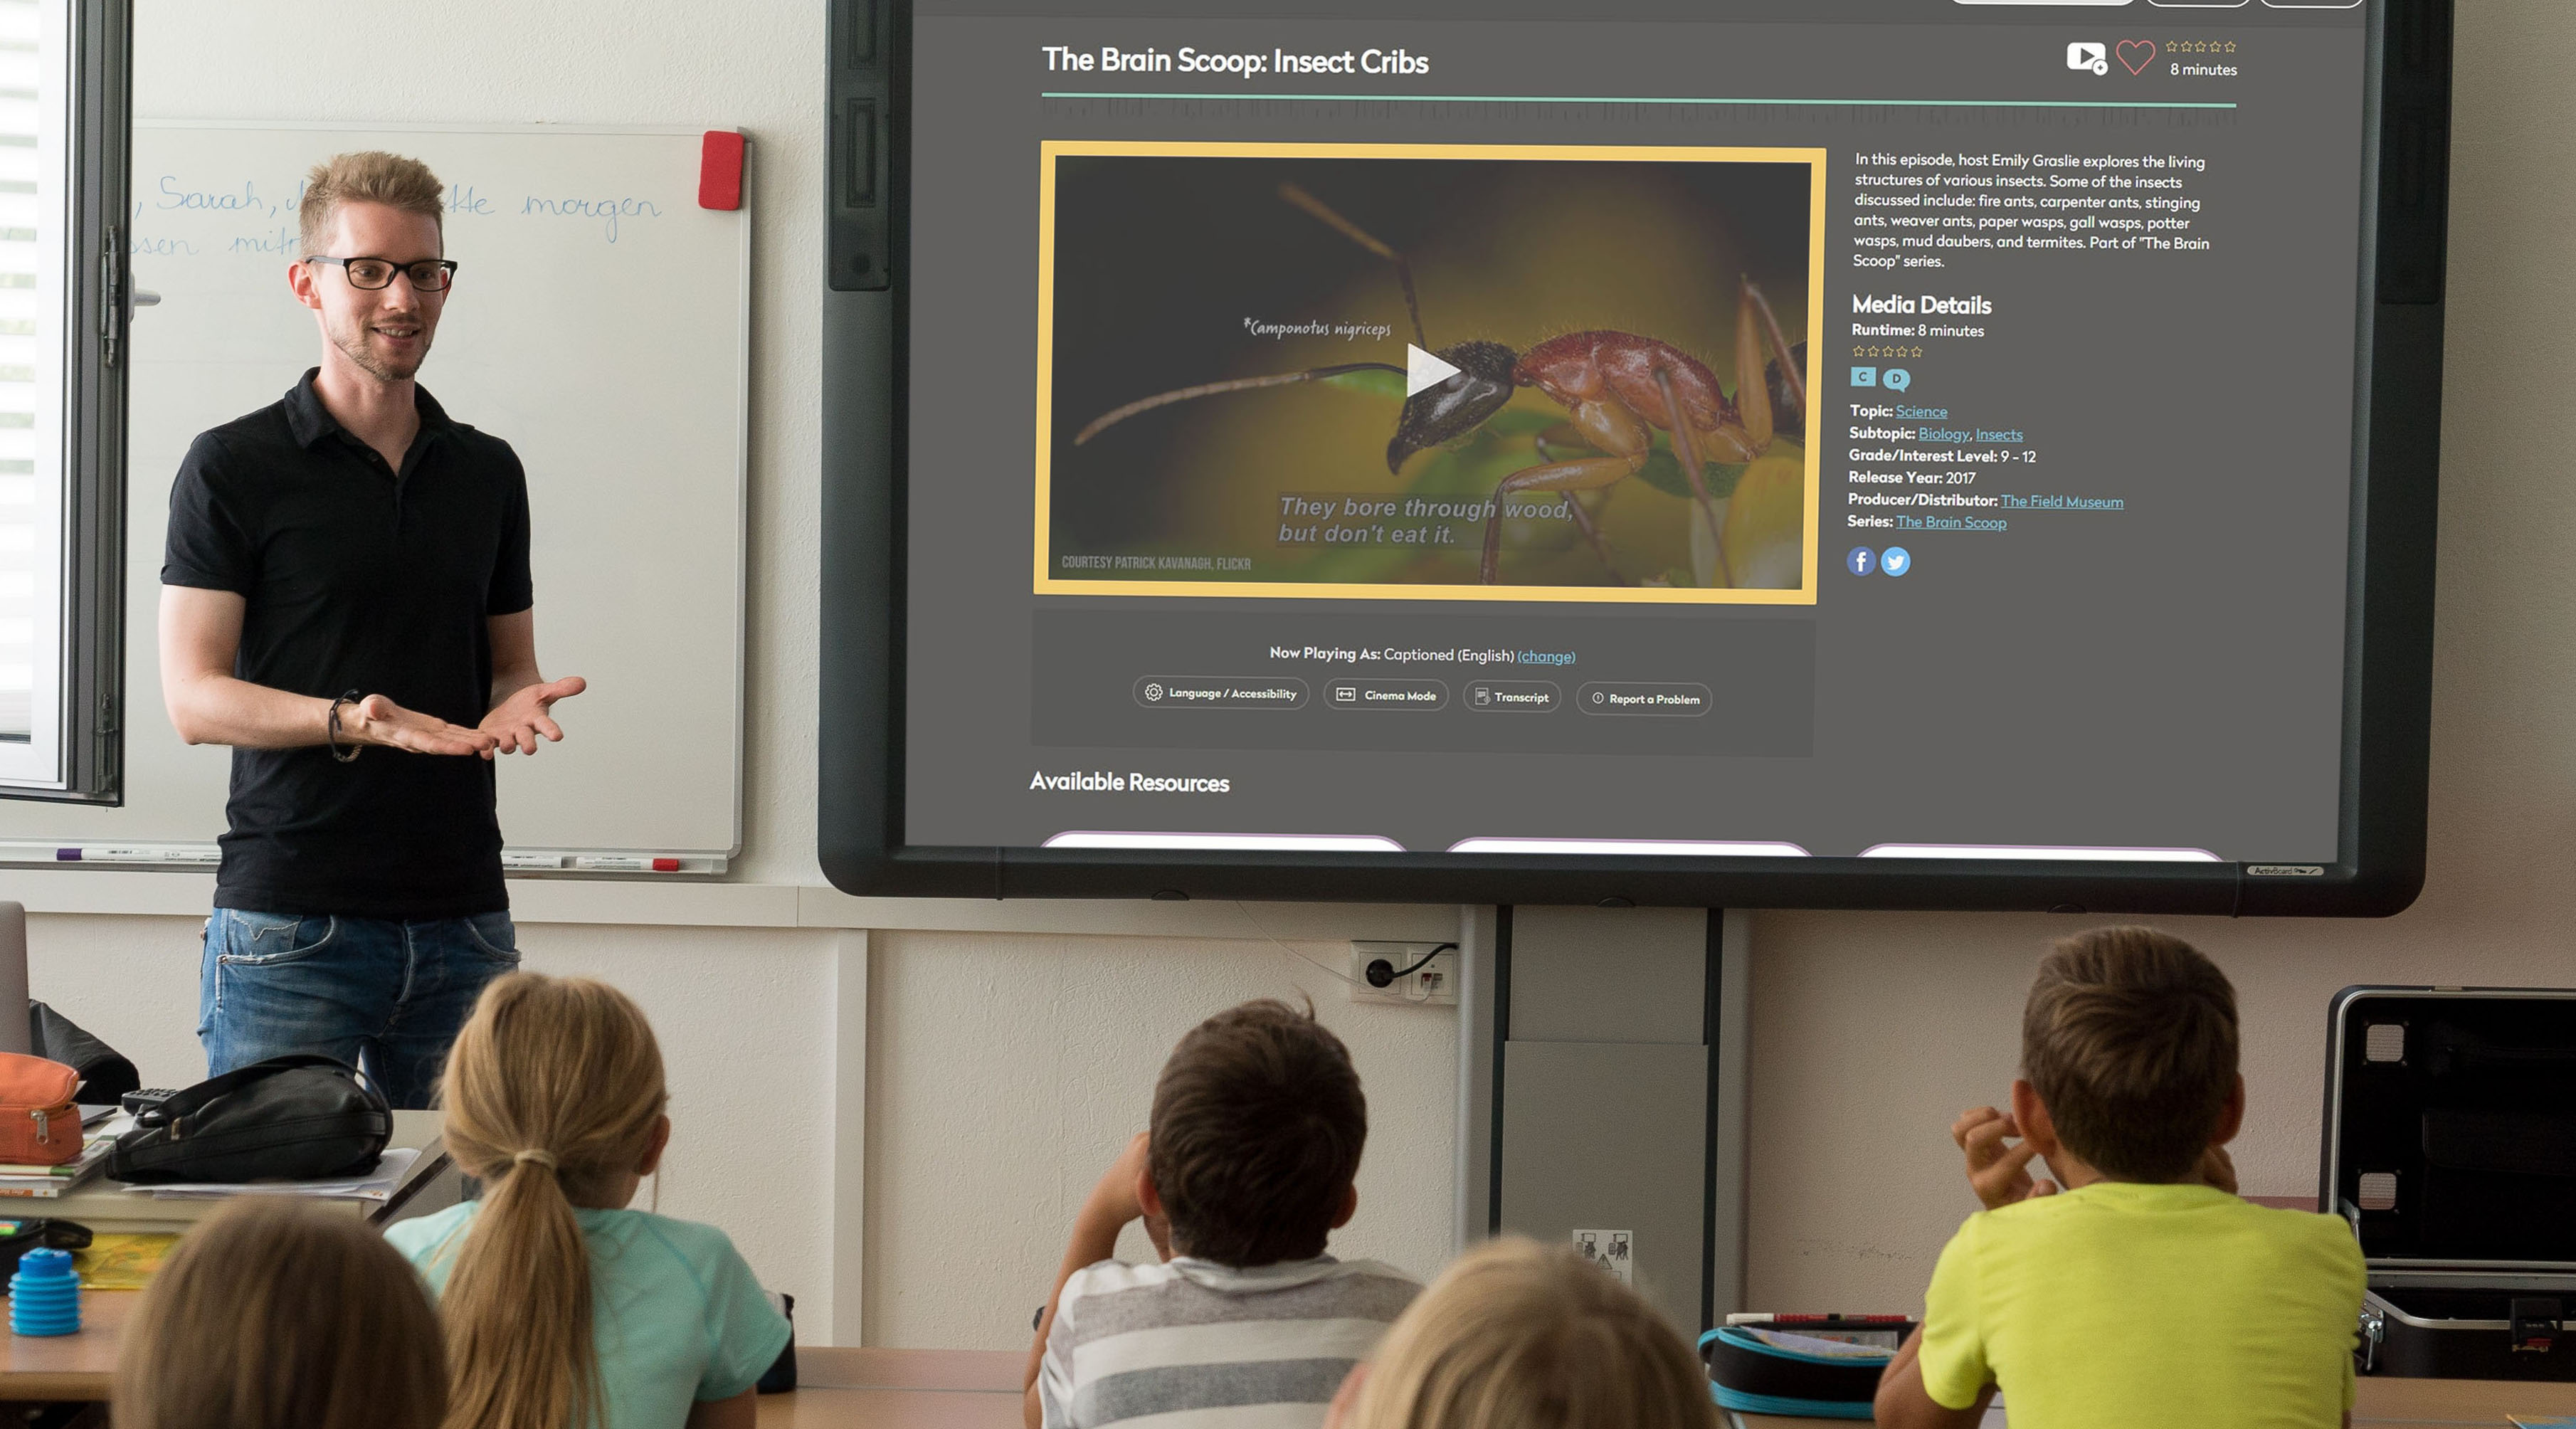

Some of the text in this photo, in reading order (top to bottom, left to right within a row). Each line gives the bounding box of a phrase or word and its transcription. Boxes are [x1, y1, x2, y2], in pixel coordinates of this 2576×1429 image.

[1042, 46, 1429, 78] The Brain Scoop: Insect Cribs
[2171, 63, 2237, 75] 8 minutes
[1857, 152, 2205, 172] In this episode, host Emily Graslie explores the living
[1856, 174, 2182, 188] structures of various insects. Some of the insects
[157, 176, 275, 218] Sarah,
[444, 184, 495, 215] tte
[522, 196, 662, 243] morgen
[1854, 193, 2200, 212] discussed include: fire ants, carpenter ants, stinging
[1854, 215, 2190, 232] ants, weaver ants, paper wasps, gall wasps, potter
[1854, 234, 2210, 251] wasps, mud daubers, and termites. Part of "The Brain
[1854, 254, 1944, 270] Scoop" series.
[1852, 294, 1992, 315] Media Details
[1334, 321, 1391, 341] nigriceps
[1852, 323, 1984, 337] Runtime: 8 minutes
[1859, 372, 1867, 382] C
[1893, 374, 1901, 384] D
[1850, 404, 1947, 420] Topic: Science
[1849, 426, 2023, 443] Subtopic: Biology, Insects
[1849, 448, 1953, 462] Grade/Interest
[1958, 450, 1997, 463] Level:
[2001, 450, 2009, 462] 9
[2022, 450, 2035, 463] 12
[1849, 470, 1975, 484] Release Year: 2017
[1849, 492, 2123, 509] Producer/Distributor: The Field Museum
[1282, 497, 1575, 522] They bore through wood,
[1847, 515, 2007, 532] Series: The Brain Scoop
[1279, 524, 1456, 544] but don't eat it.
[1062, 556, 1252, 571] COURTESY PATRICK KAVANAGH, FLICKR
[1270, 646, 1575, 665] Now Playing As: Captioned (English) (change)
[1170, 687, 1298, 701] Language / Accessibility
[1366, 690, 1436, 700] Cinema Mode
[1494, 692, 1549, 705] Transcript
[1610, 694, 1645, 706] Report
[1657, 695, 1700, 705] Problem
[1030, 771, 1230, 792] Available Resources
